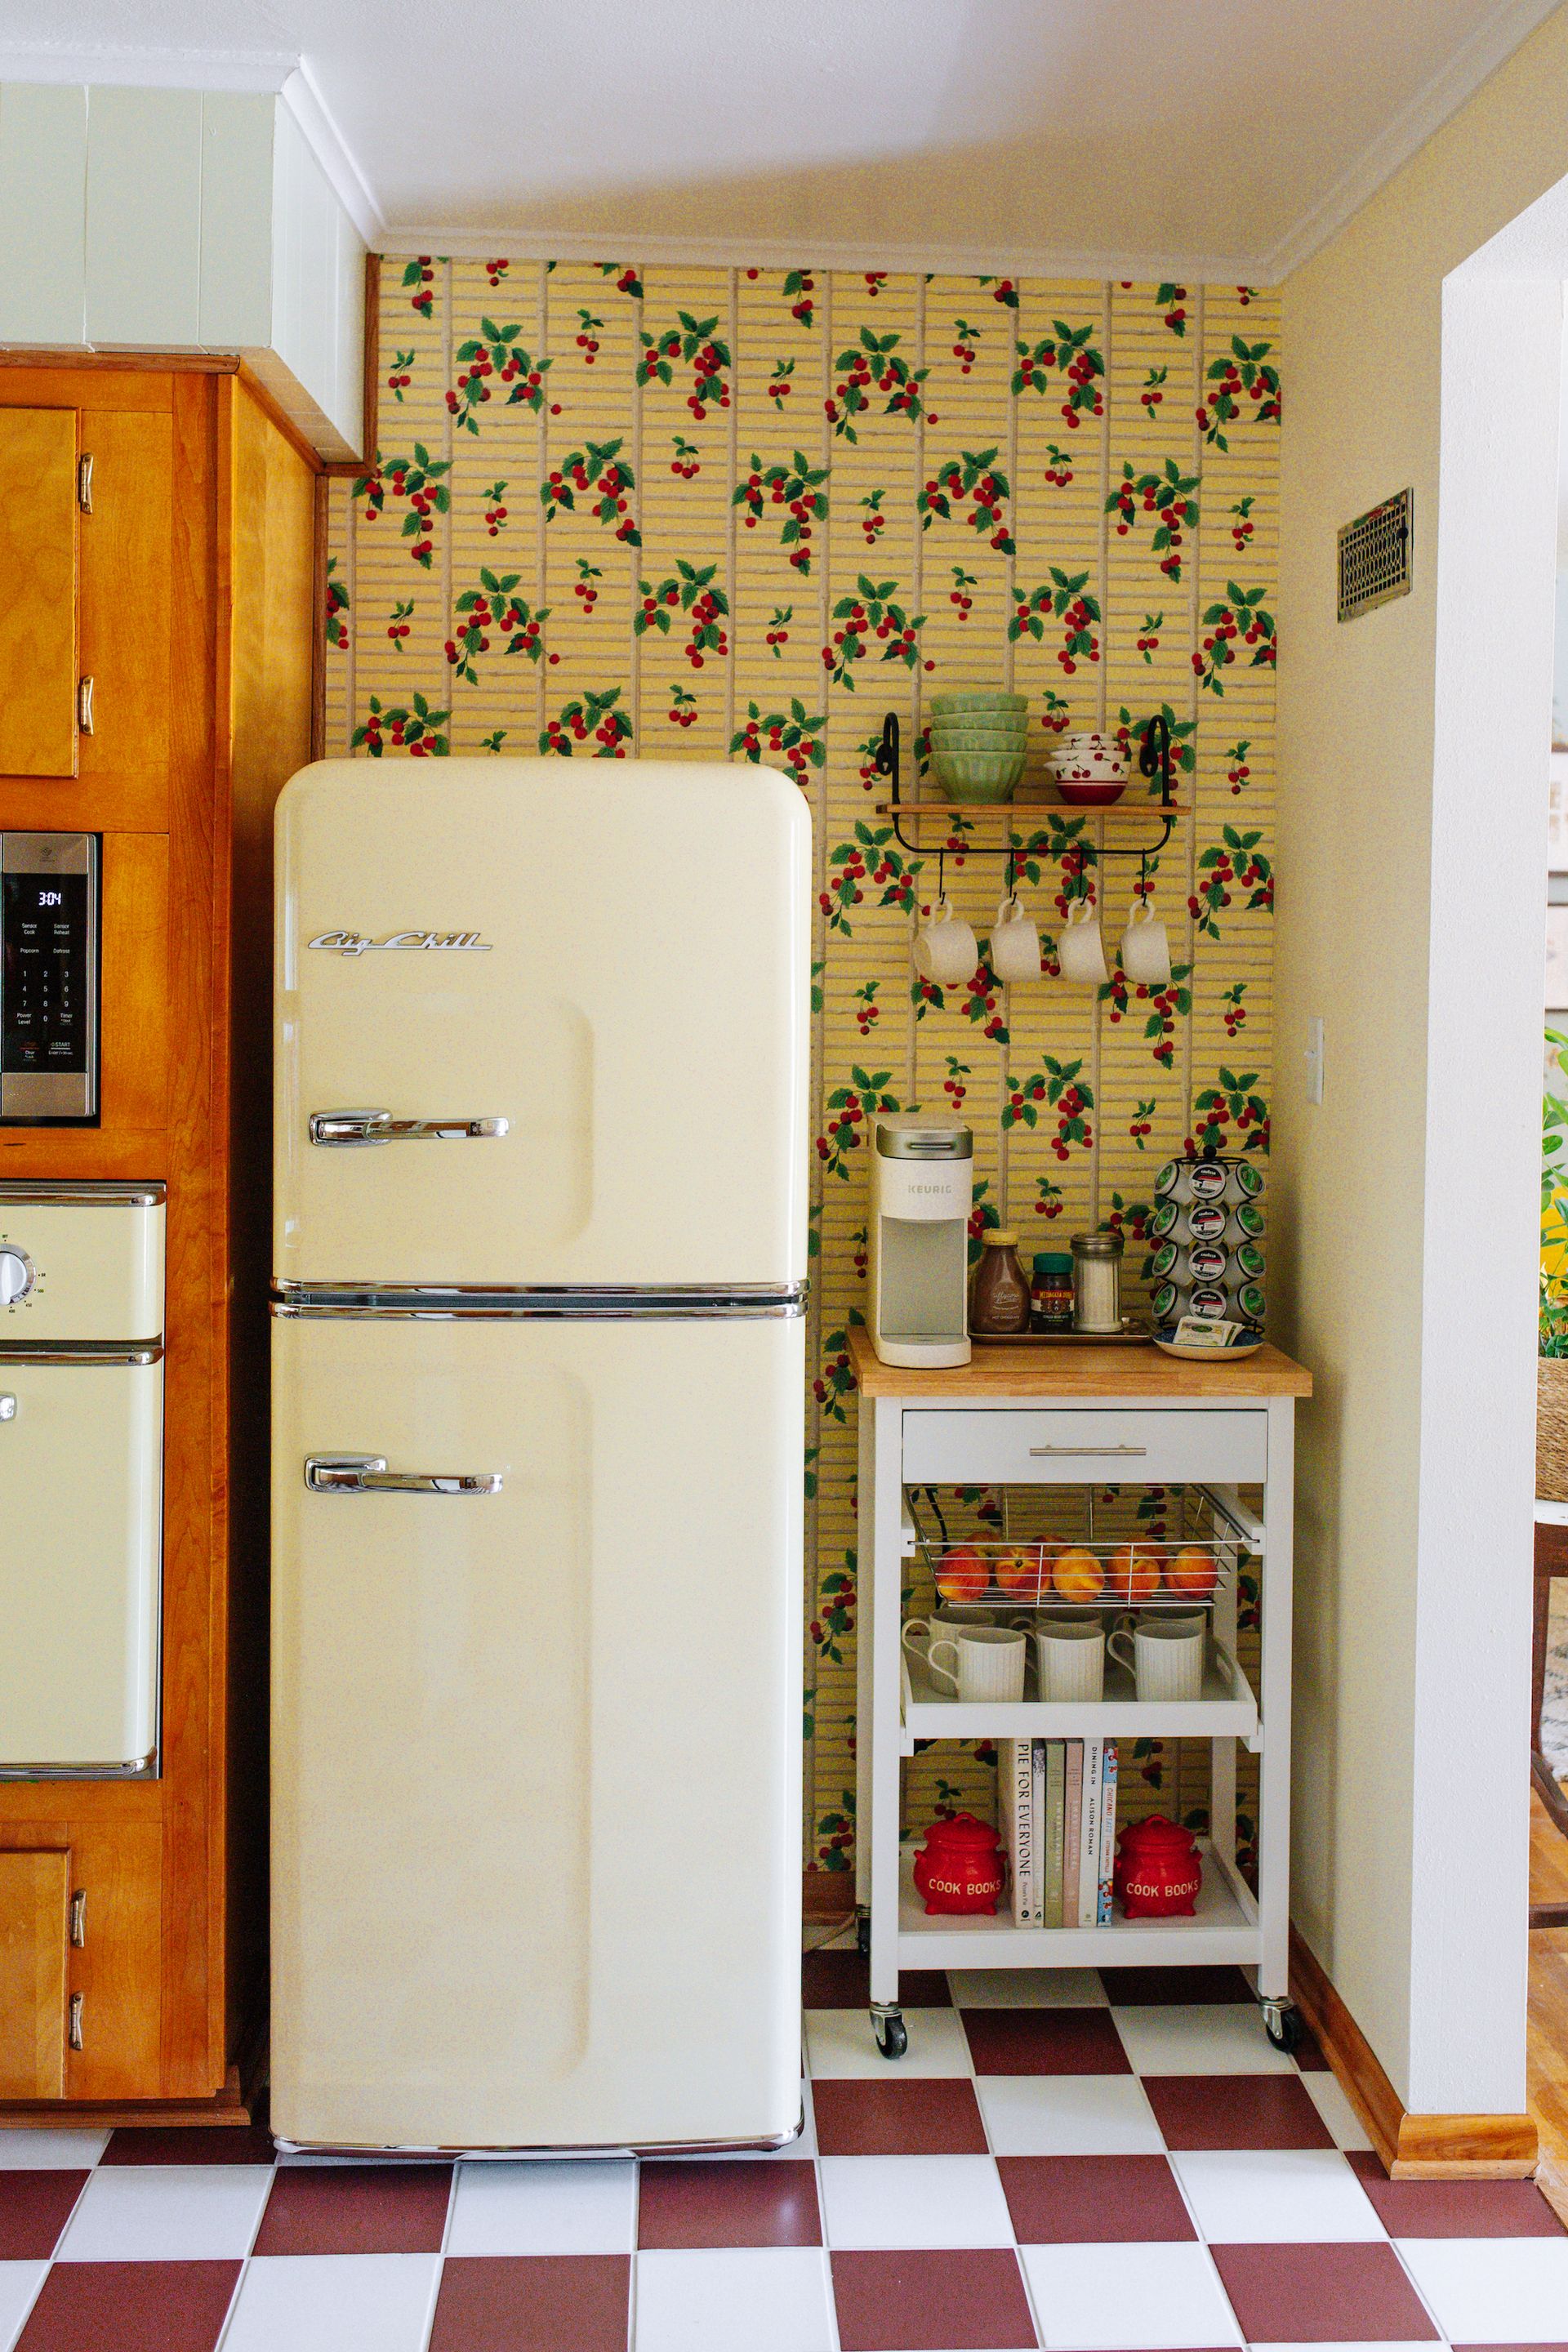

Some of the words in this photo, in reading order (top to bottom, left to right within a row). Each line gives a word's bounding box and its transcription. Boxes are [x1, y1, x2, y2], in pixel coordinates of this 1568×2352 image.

[38, 892, 62, 906] 3:04
[308, 931, 372, 956] Big
[382, 931, 493, 951] Chill
[907, 1185, 952, 1194] KEURIG
[1018, 1744, 1029, 1764] PIE
[1018, 1771, 1030, 1798] FOR
[1090, 1776, 1096, 1785] IN
[1018, 1805, 1031, 1877] EVERYONE
[929, 1878, 962, 1895] COOK
[966, 1879, 1001, 1895] BOOKS
[1126, 1882, 1160, 1897] COOK
[1164, 1880, 1199, 1897] BOOKS
